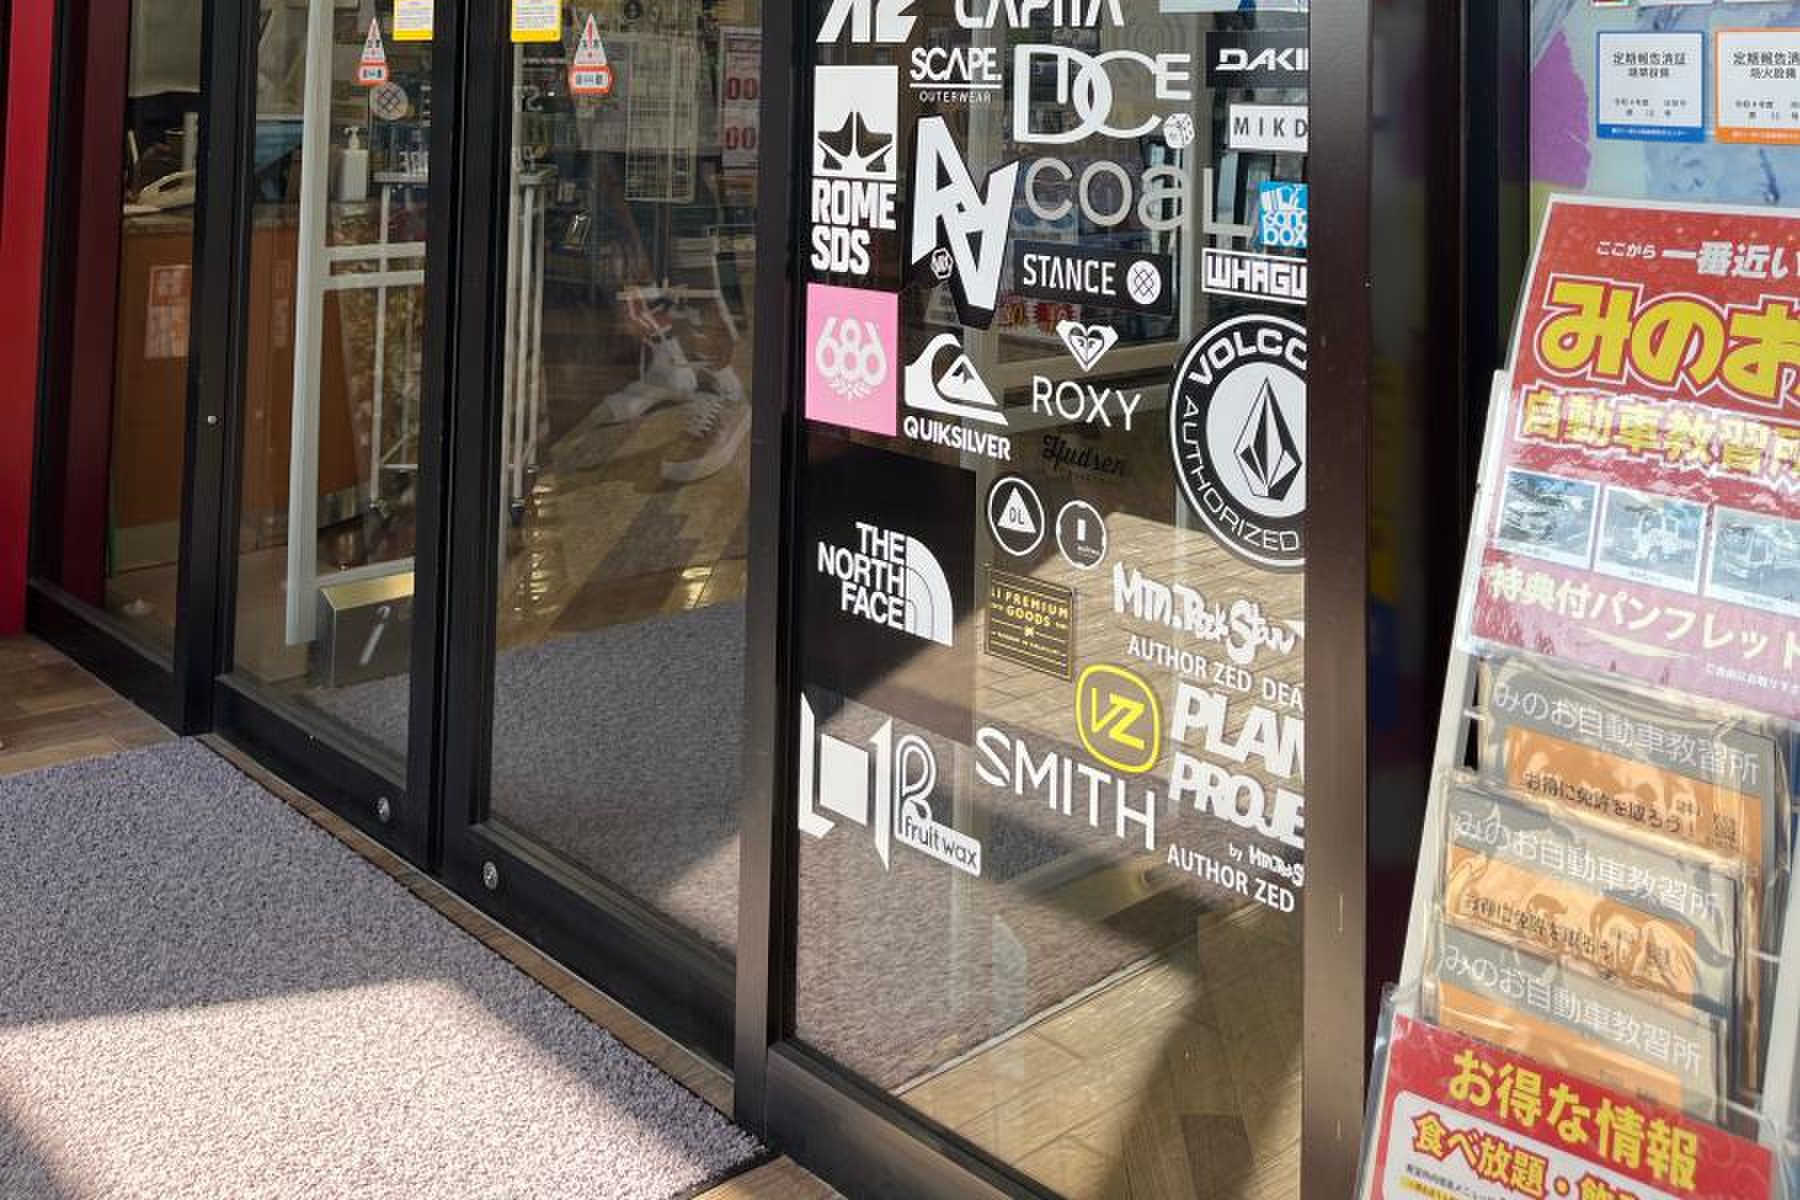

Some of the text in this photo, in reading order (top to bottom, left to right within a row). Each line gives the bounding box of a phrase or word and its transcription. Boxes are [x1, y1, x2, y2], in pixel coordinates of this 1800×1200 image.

[812, 178, 897, 231] ROME
[810, 224, 871, 276] SDS
[1597, 240, 1657, 258] ここから
[1023, 253, 1117, 297] STANCE
[1033, 374, 1142, 432] ROXY
[903, 415, 1012, 462] QUIKSILVER
[817, 540, 905, 598] NORTH
[855, 521, 906, 566] THE
[841, 580, 905, 631] FACE
[1005, 590, 1069, 619] PREMIUM
[1007, 605, 1051, 627] GOODS
[1494, 680, 1760, 786] みのお自動車教習所
[975, 725, 1156, 851] SMITH
[942, 840, 978, 868] wax
[1440, 942, 1703, 1076] みのお自動車教習所
[1449, 1048, 1697, 1192] お得な情報
